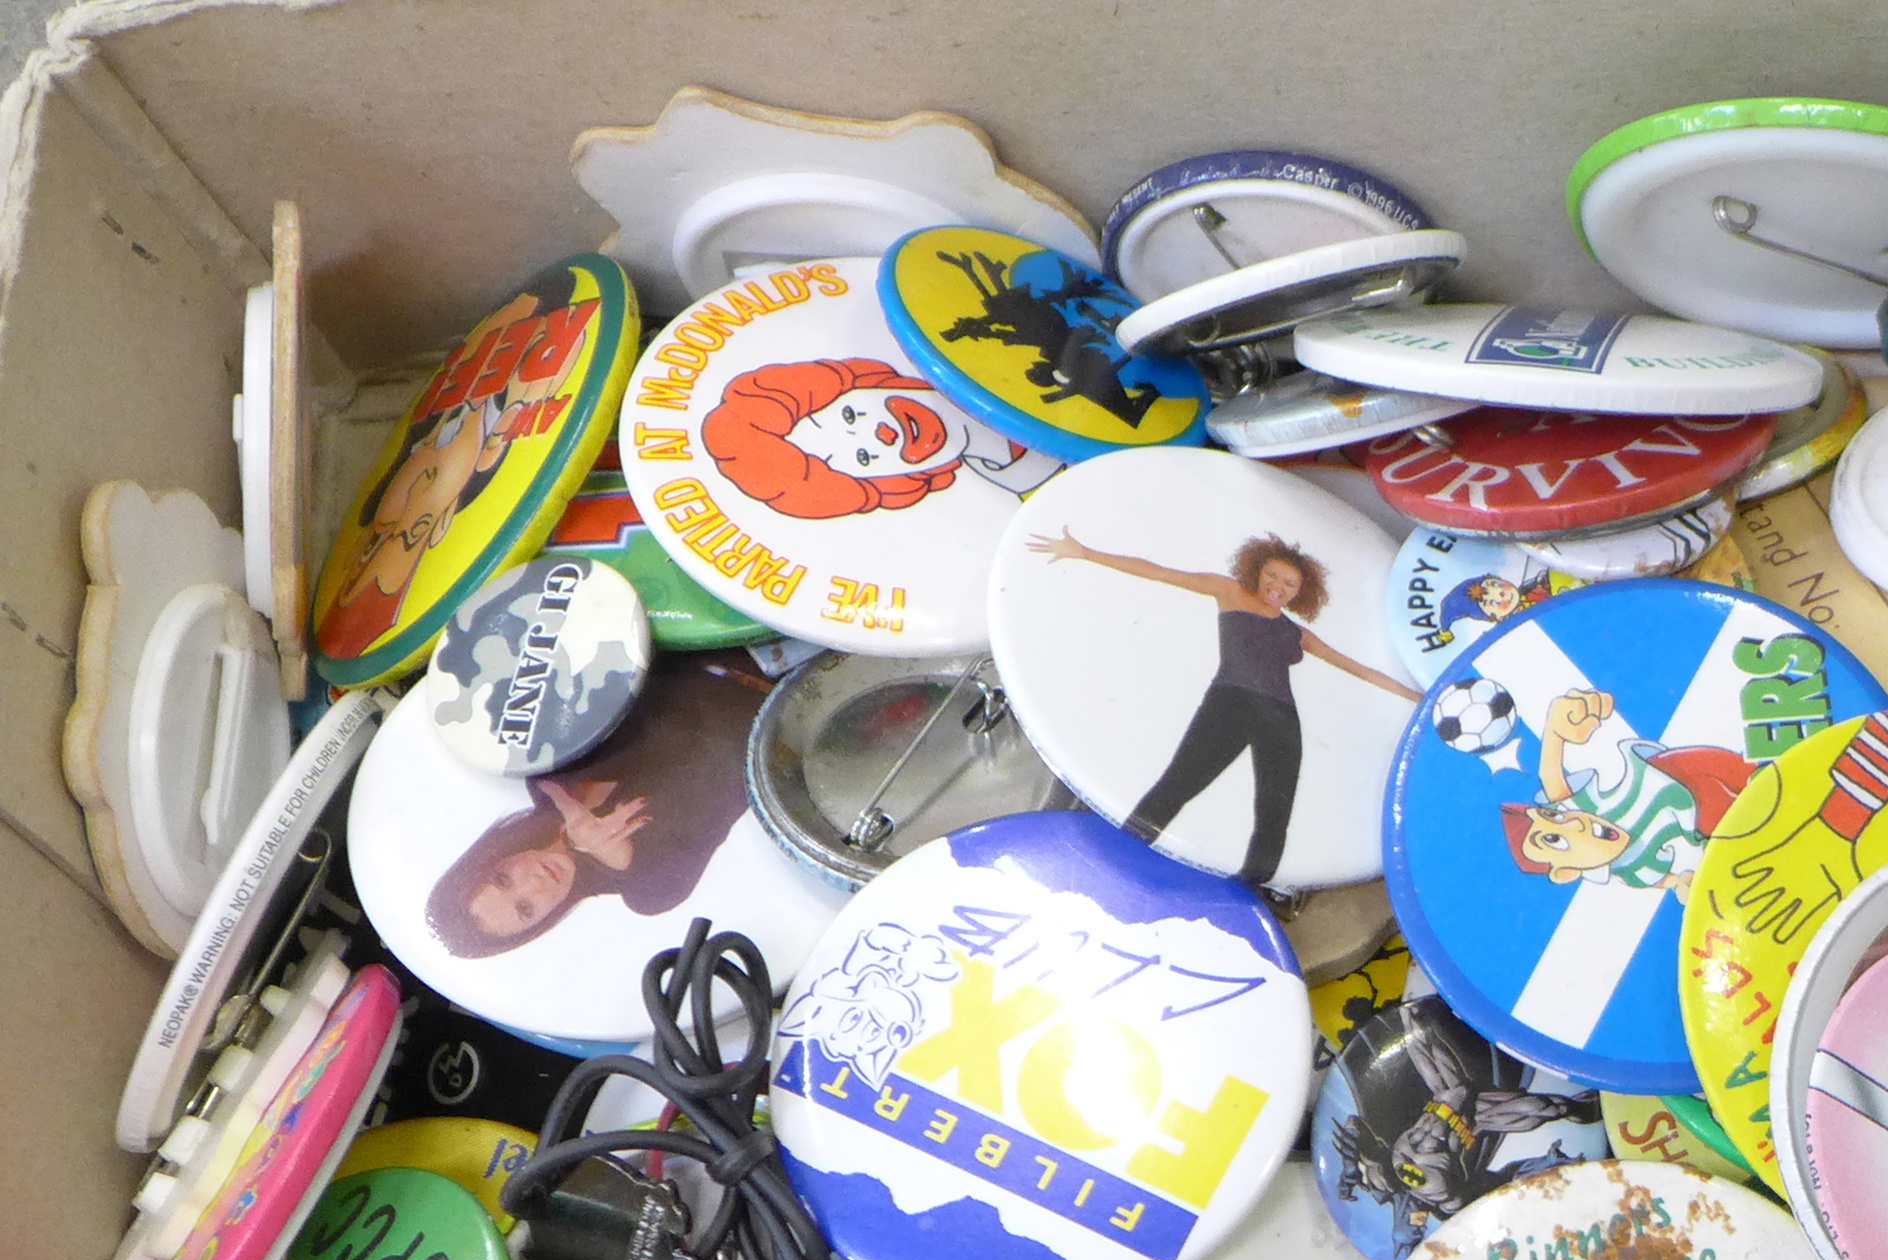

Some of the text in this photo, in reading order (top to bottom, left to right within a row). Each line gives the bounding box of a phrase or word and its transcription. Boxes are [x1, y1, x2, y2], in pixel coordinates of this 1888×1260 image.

[634, 263, 906, 632] I'VE PARTIED AT McDONALD'S
[498, 561, 584, 750] GI JANE
[1406, 557, 1446, 656] HAPPY
[230, 874, 257, 913] NOT
[248, 809, 292, 881] SUITABLE
[284, 786, 308, 821] FOR
[300, 737, 341, 793] CHILDREN
[821, 1067, 1146, 1232] FILBERT
[896, 948, 1271, 1209] FOX
